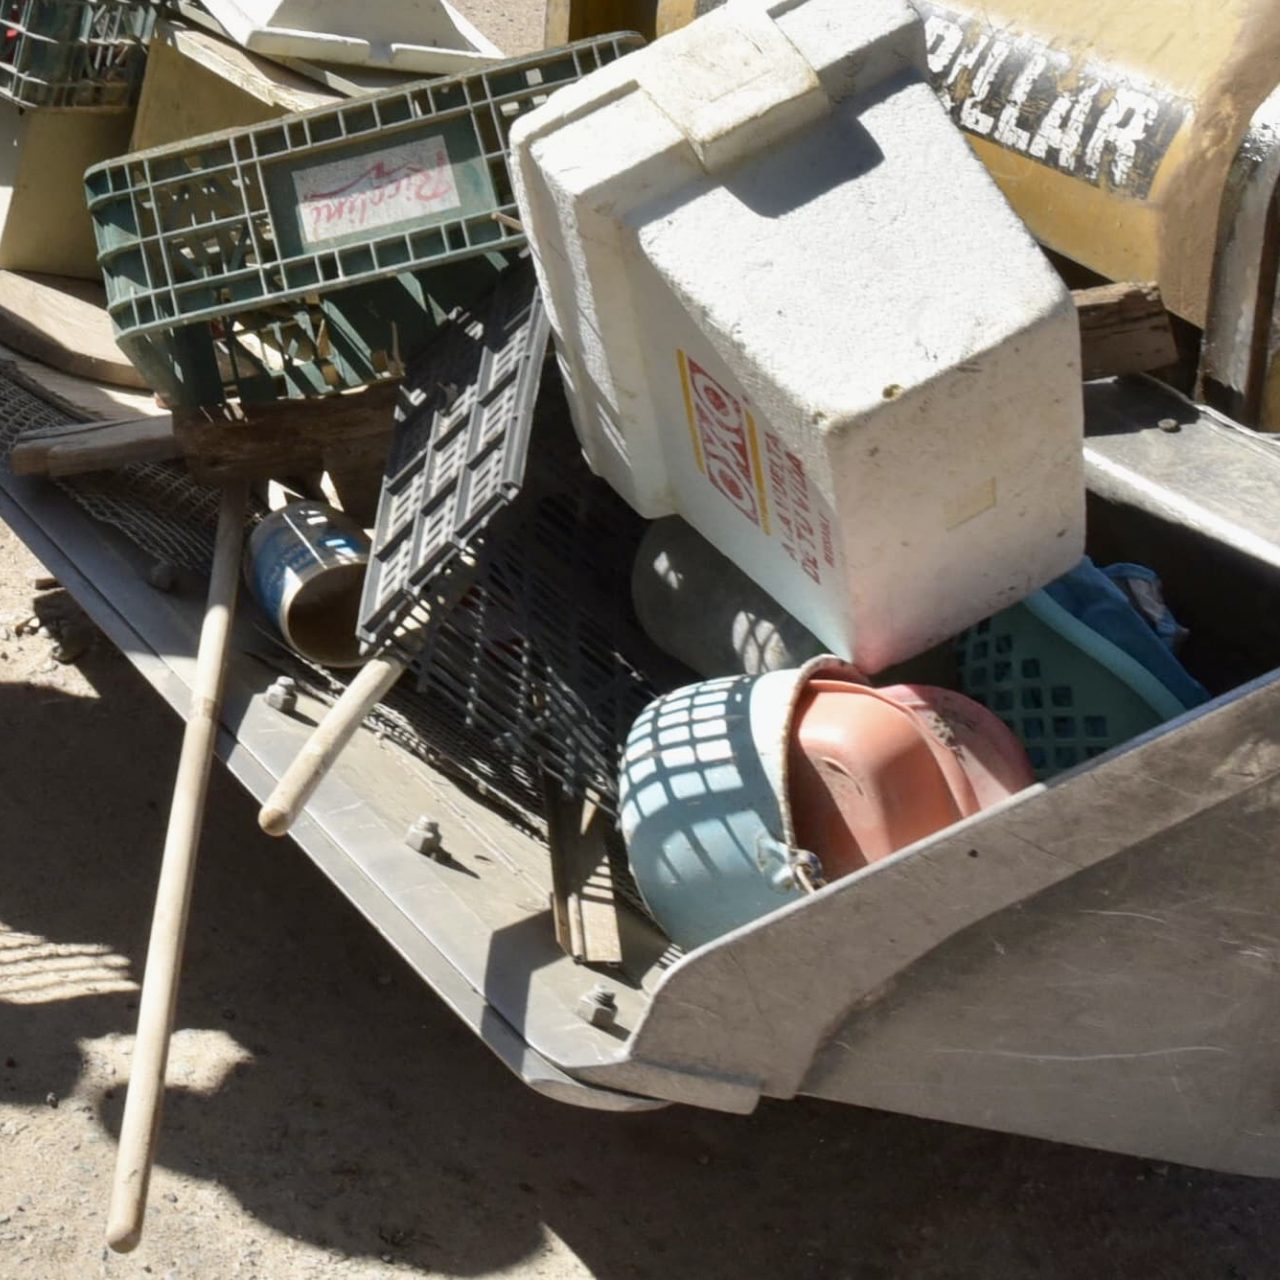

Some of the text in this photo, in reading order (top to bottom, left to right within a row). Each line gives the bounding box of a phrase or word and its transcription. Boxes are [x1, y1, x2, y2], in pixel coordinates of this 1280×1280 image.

[688, 357, 758, 525] OXXO
[785, 451, 821, 585] DE TU VIDA
